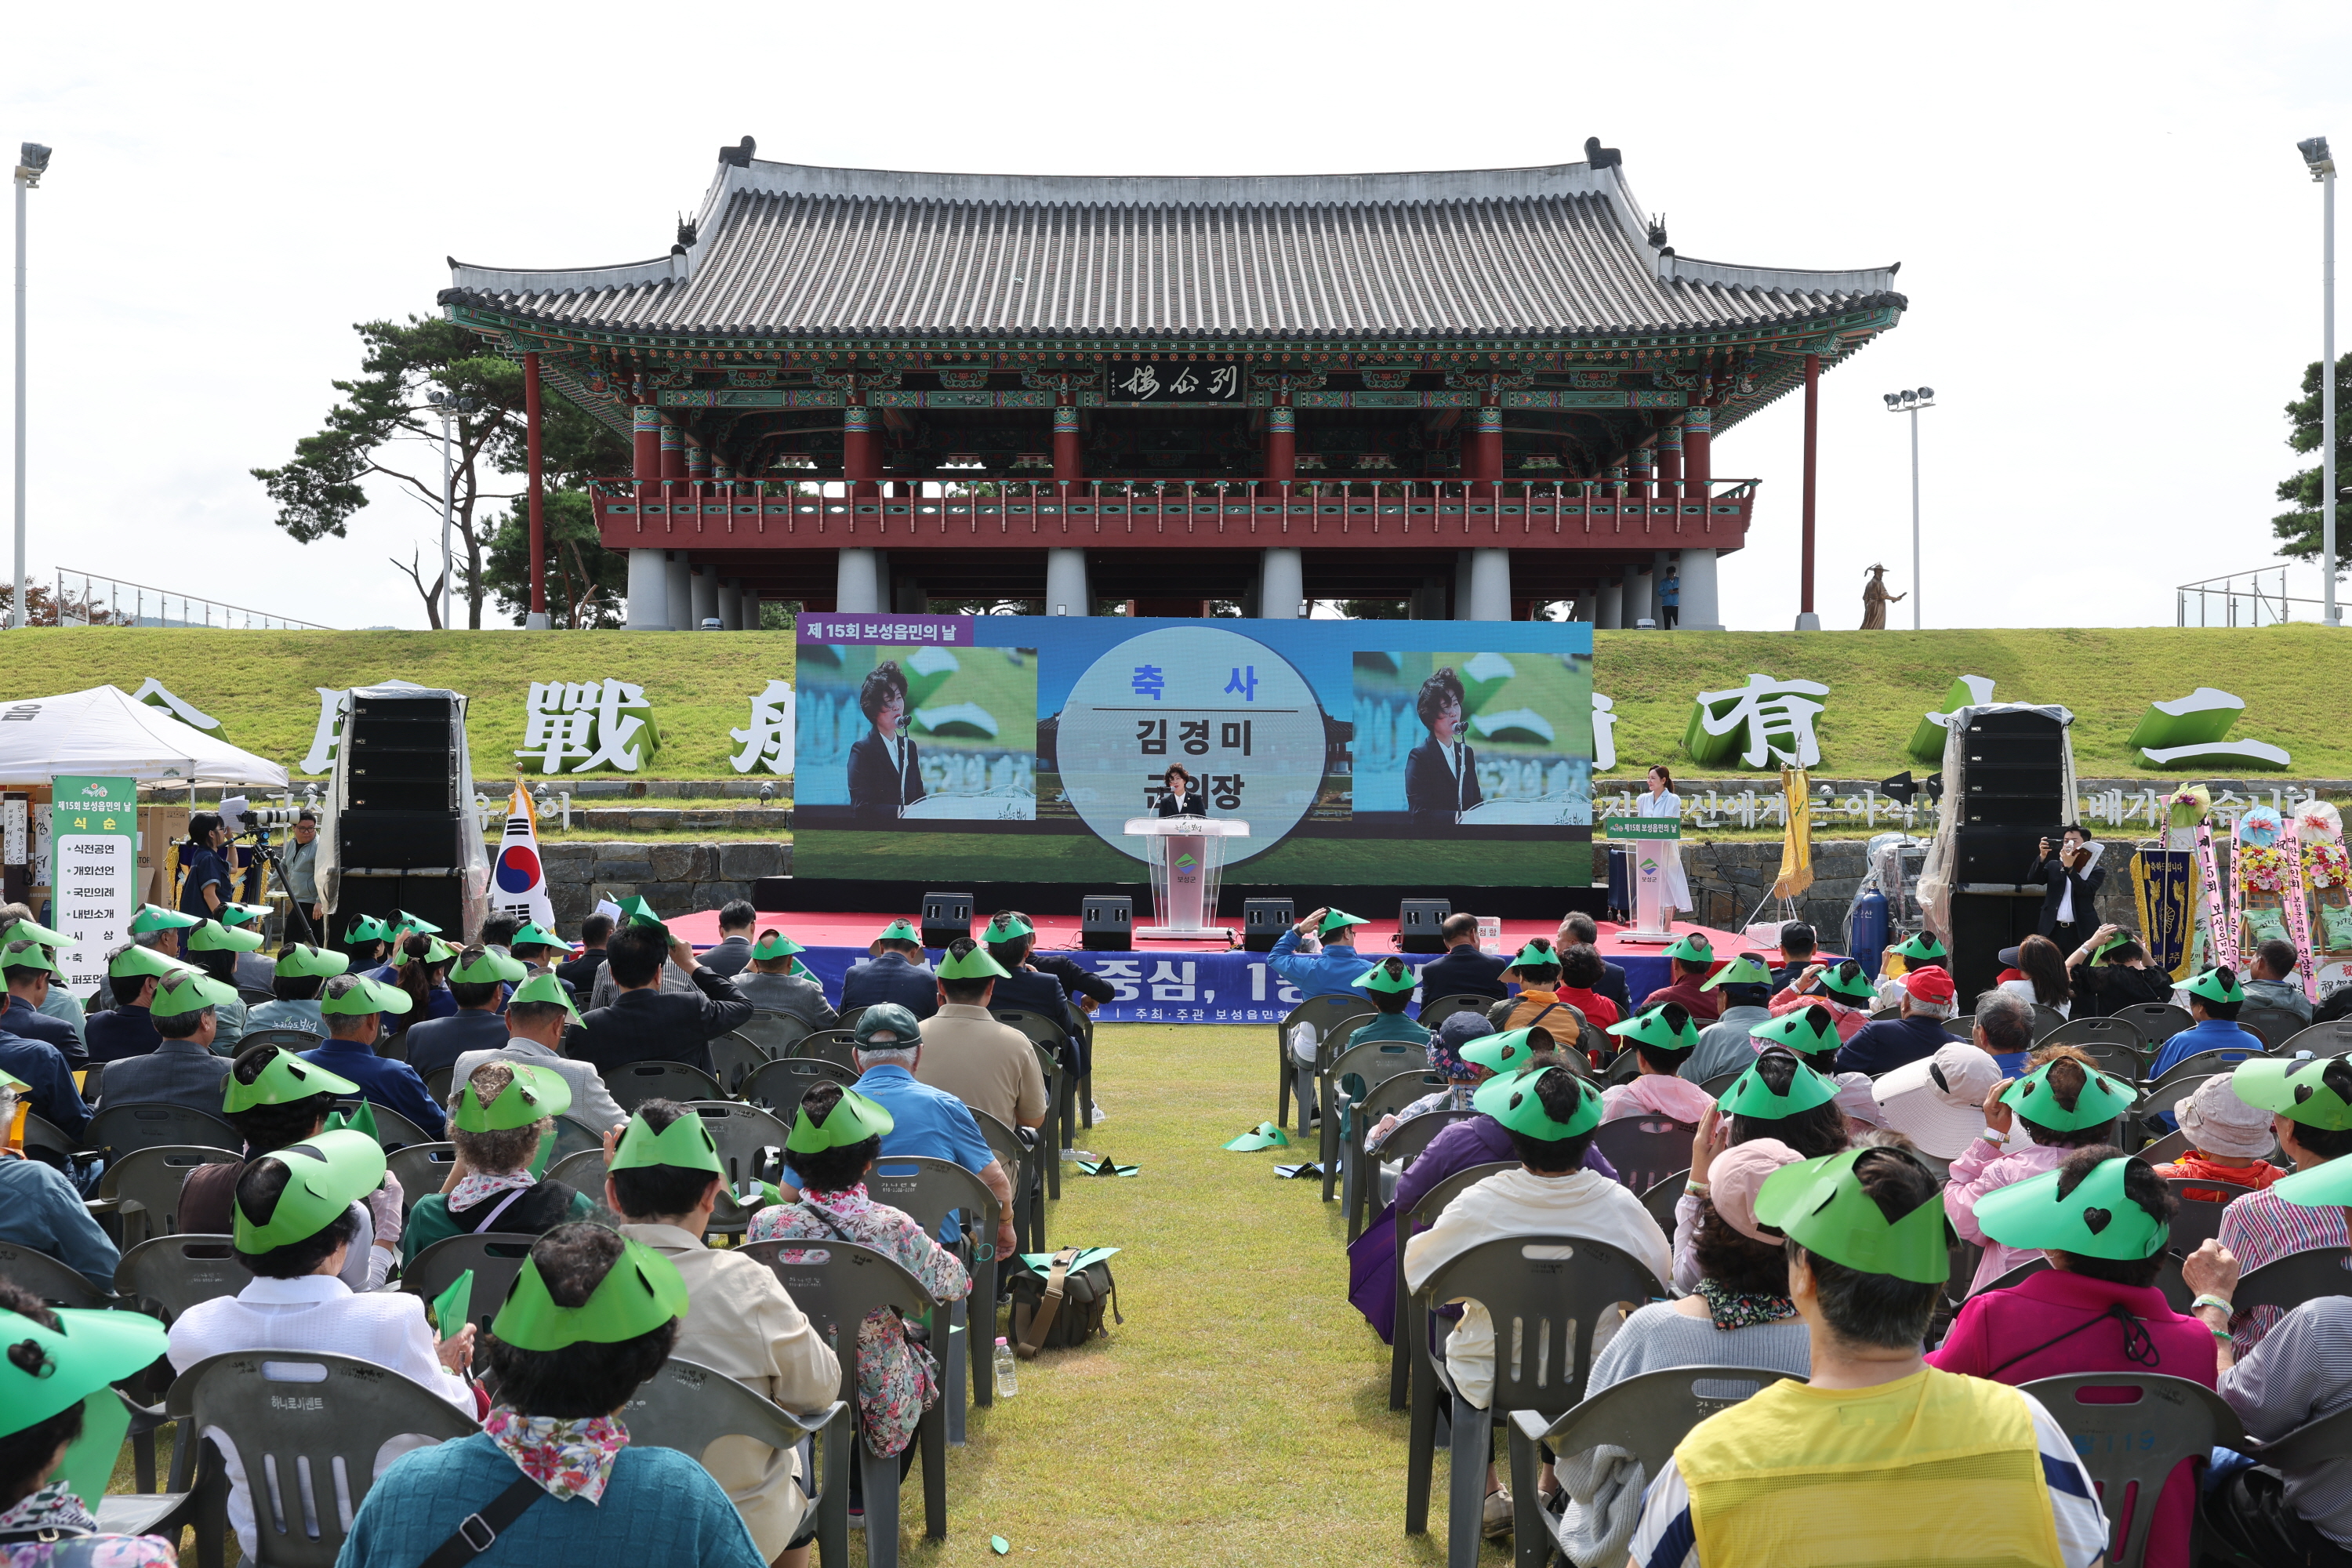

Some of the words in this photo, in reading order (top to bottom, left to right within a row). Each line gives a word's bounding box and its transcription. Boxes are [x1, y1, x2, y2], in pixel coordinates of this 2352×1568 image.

[807, 622, 822, 639] 제
[826, 623, 860, 639] 15회
[863, 624, 938, 641] 보성읍민의
[942, 625, 956, 641] 날
[58, 800, 81, 811] 제15회
[82, 800, 121, 812] 보성읍민의
[124, 801, 132, 812] 날
[74, 817, 86, 829] 식
[103, 817, 116, 830] 순
[1624, 823, 1640, 833] 제15회
[1641, 823, 1669, 833] 보성읍민의
[1671, 824, 1677, 833] 날
[74, 844, 114, 855] 식전공연
[73, 866, 114, 876] 개회선언
[73, 887, 114, 898] 국민의례
[73, 909, 114, 919] 내빈소개
[272, 1020, 299, 1029] 녹차수도
[299, 1018, 318, 1033] 보성
